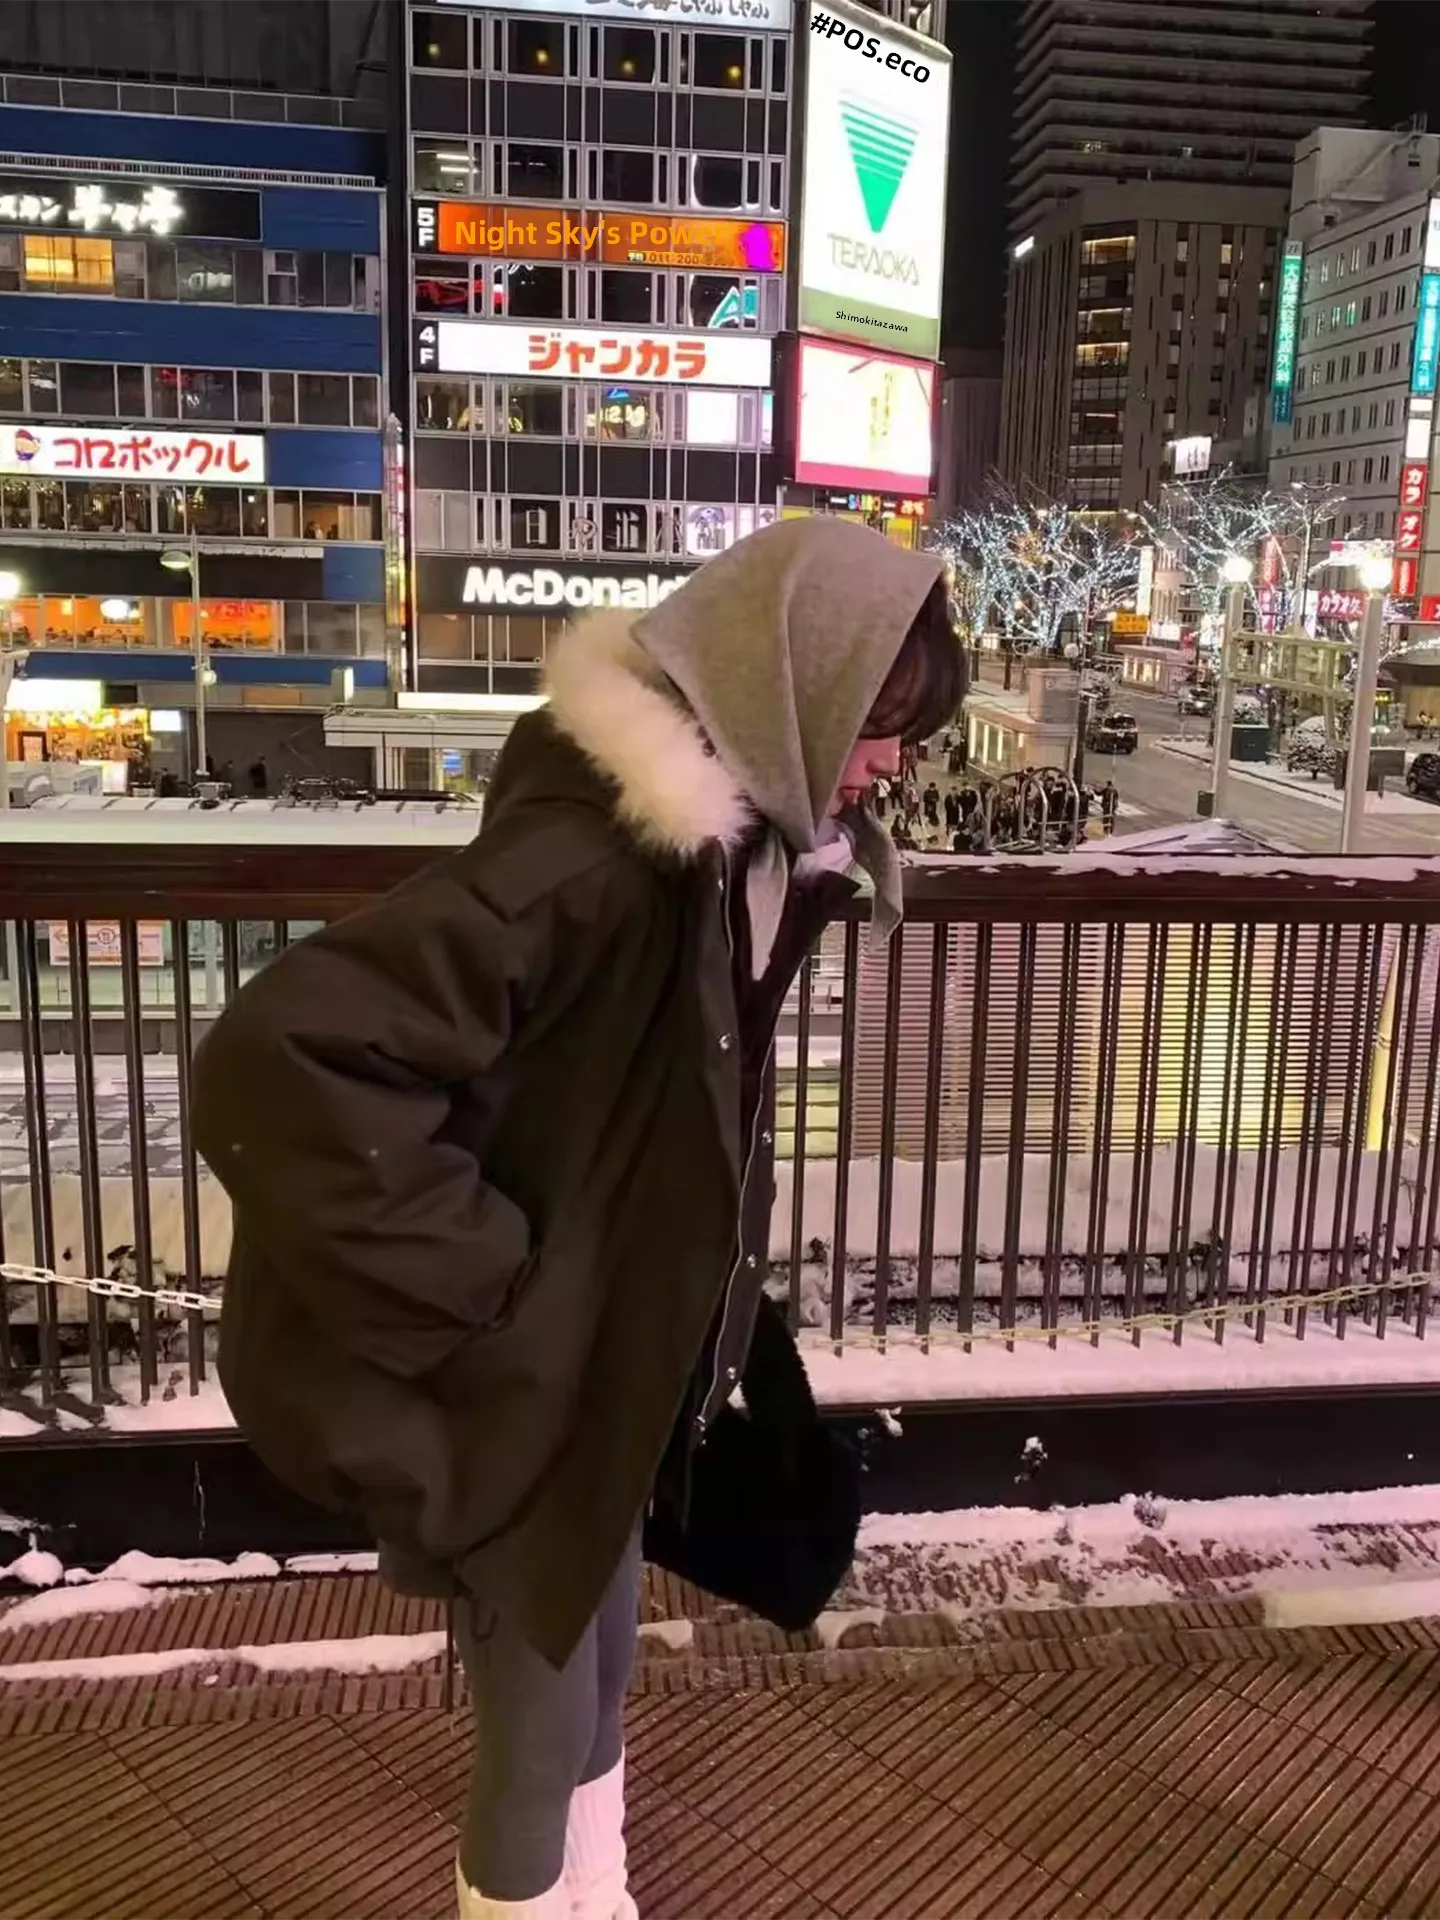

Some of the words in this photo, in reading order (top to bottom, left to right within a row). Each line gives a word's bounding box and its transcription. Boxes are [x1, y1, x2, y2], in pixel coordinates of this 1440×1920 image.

[810, 12, 931, 83] #POS.eco
[418, 207, 435, 246] 5F
[455, 222, 537, 250] Night
[546, 219, 621, 250] Sky's
[631, 222, 723, 245] Power
[827, 232, 920, 286] TERAOKA
[836, 311, 908, 333] Shimokitazawa
[528, 332, 706, 379] ジャンカラ
[53, 435, 249, 475] コロボックル
